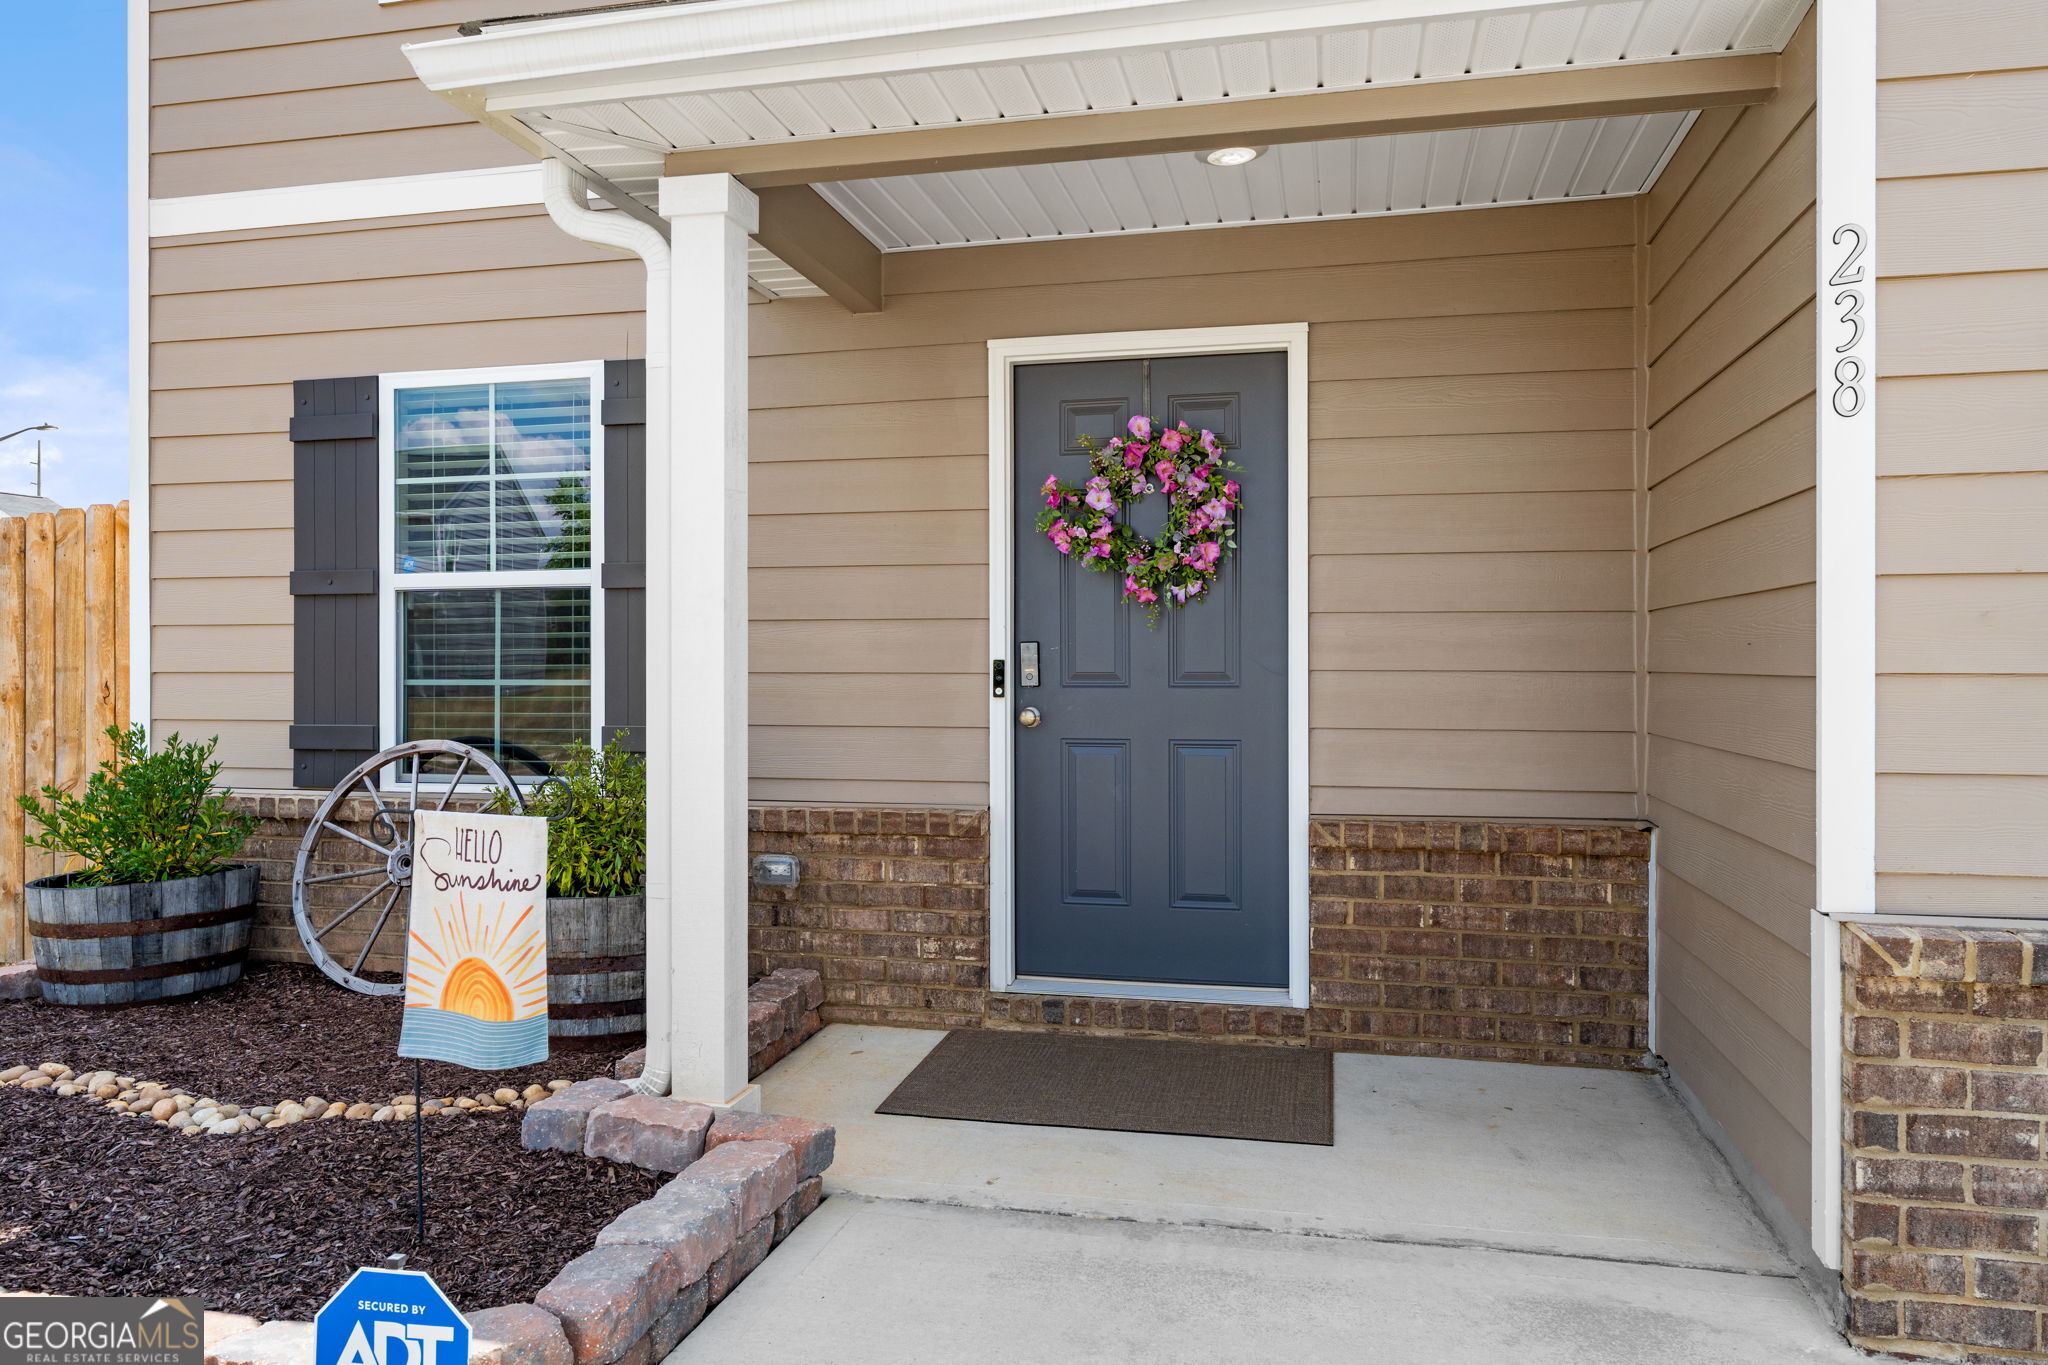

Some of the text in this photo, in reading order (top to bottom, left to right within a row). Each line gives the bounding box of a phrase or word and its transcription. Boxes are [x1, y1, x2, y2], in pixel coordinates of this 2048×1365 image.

[1828, 222, 1868, 418] 238
[420, 837, 542, 892] Sunshine
[455, 826, 503, 865] HELLO
[357, 1300, 427, 1315] SECURED BY
[336, 1319, 455, 1365] ADT
